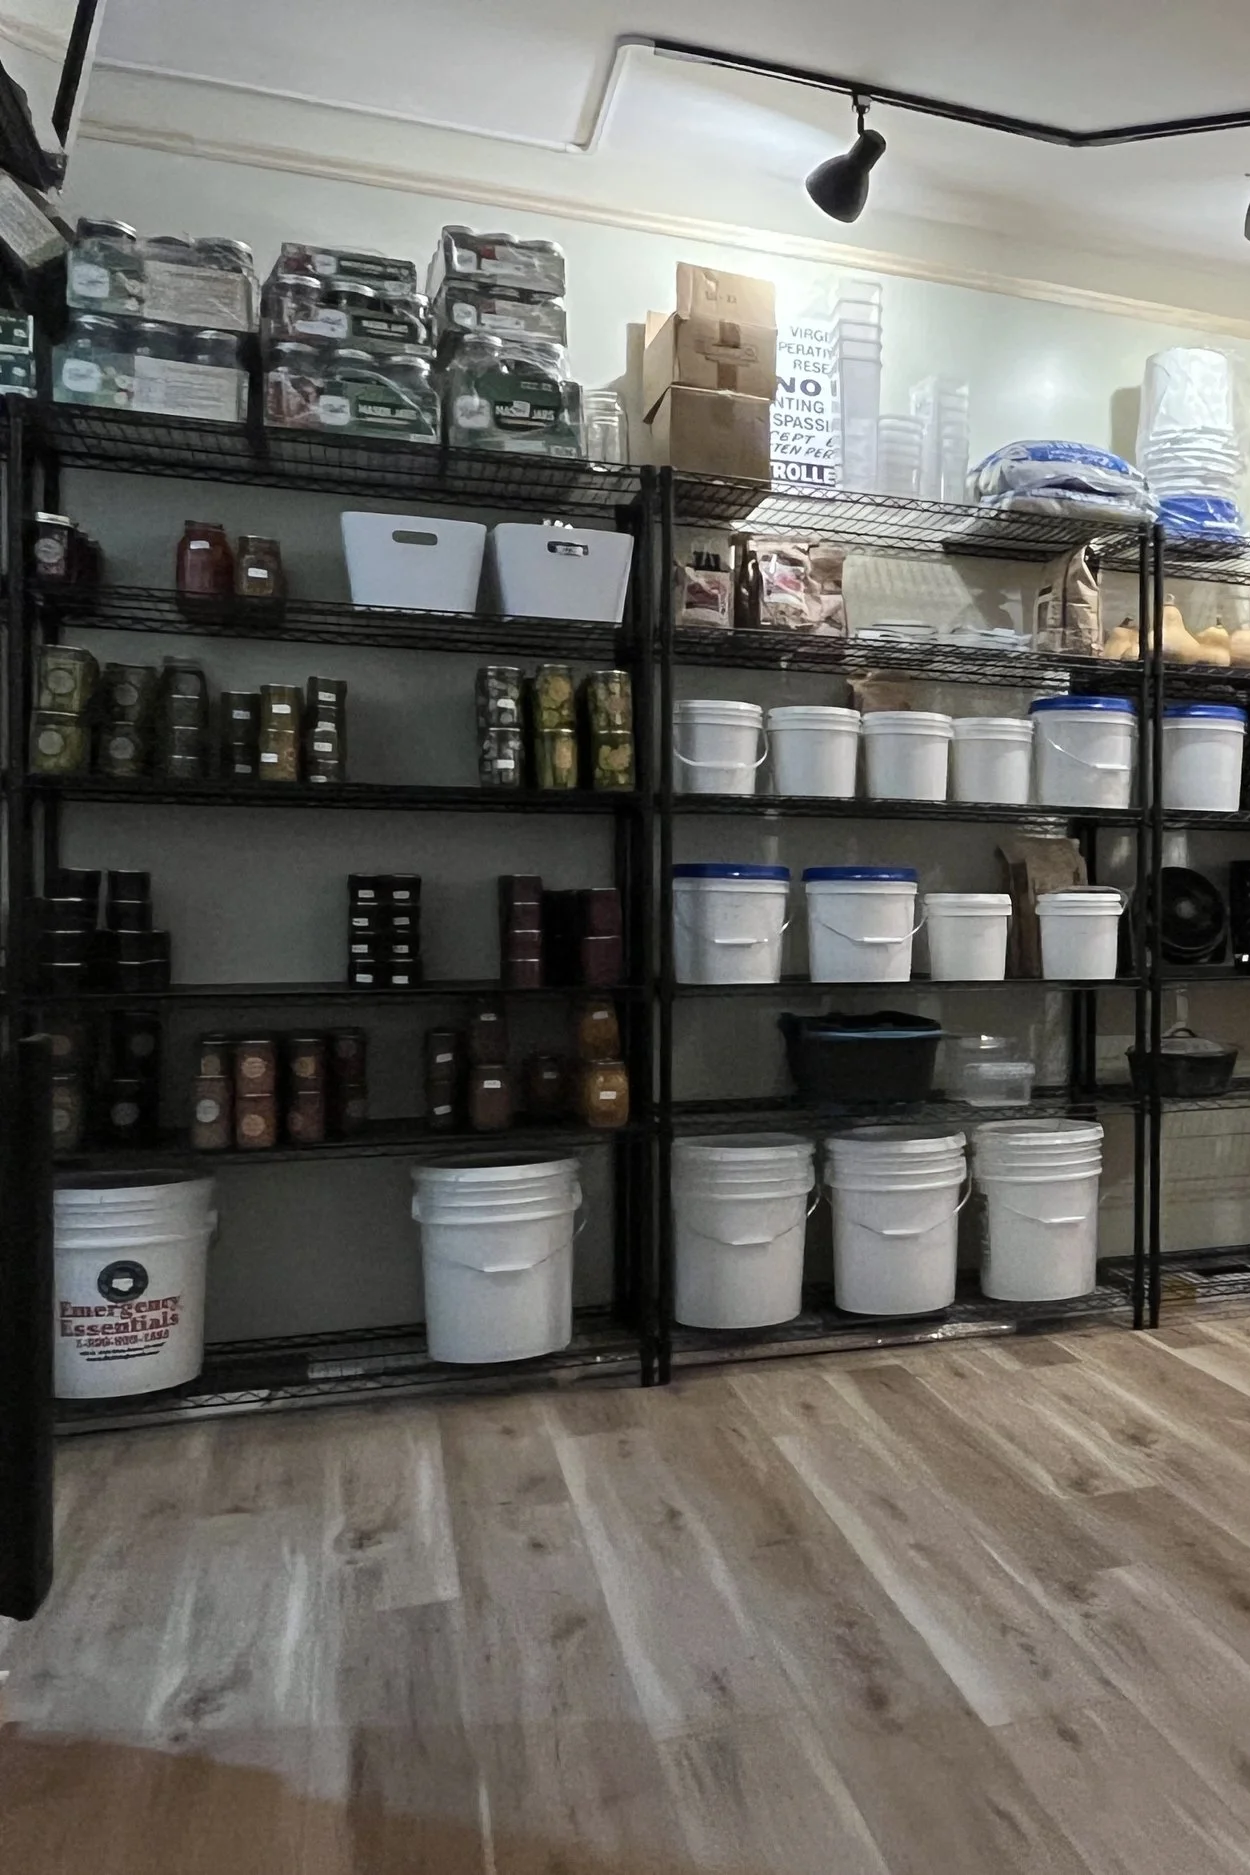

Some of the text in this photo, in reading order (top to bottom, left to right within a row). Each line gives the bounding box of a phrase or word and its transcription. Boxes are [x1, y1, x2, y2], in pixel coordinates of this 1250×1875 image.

[776, 376, 822, 397] NO
[60, 1296, 181, 1320] Emergency
[60, 1312, 180, 1338] Essentials
